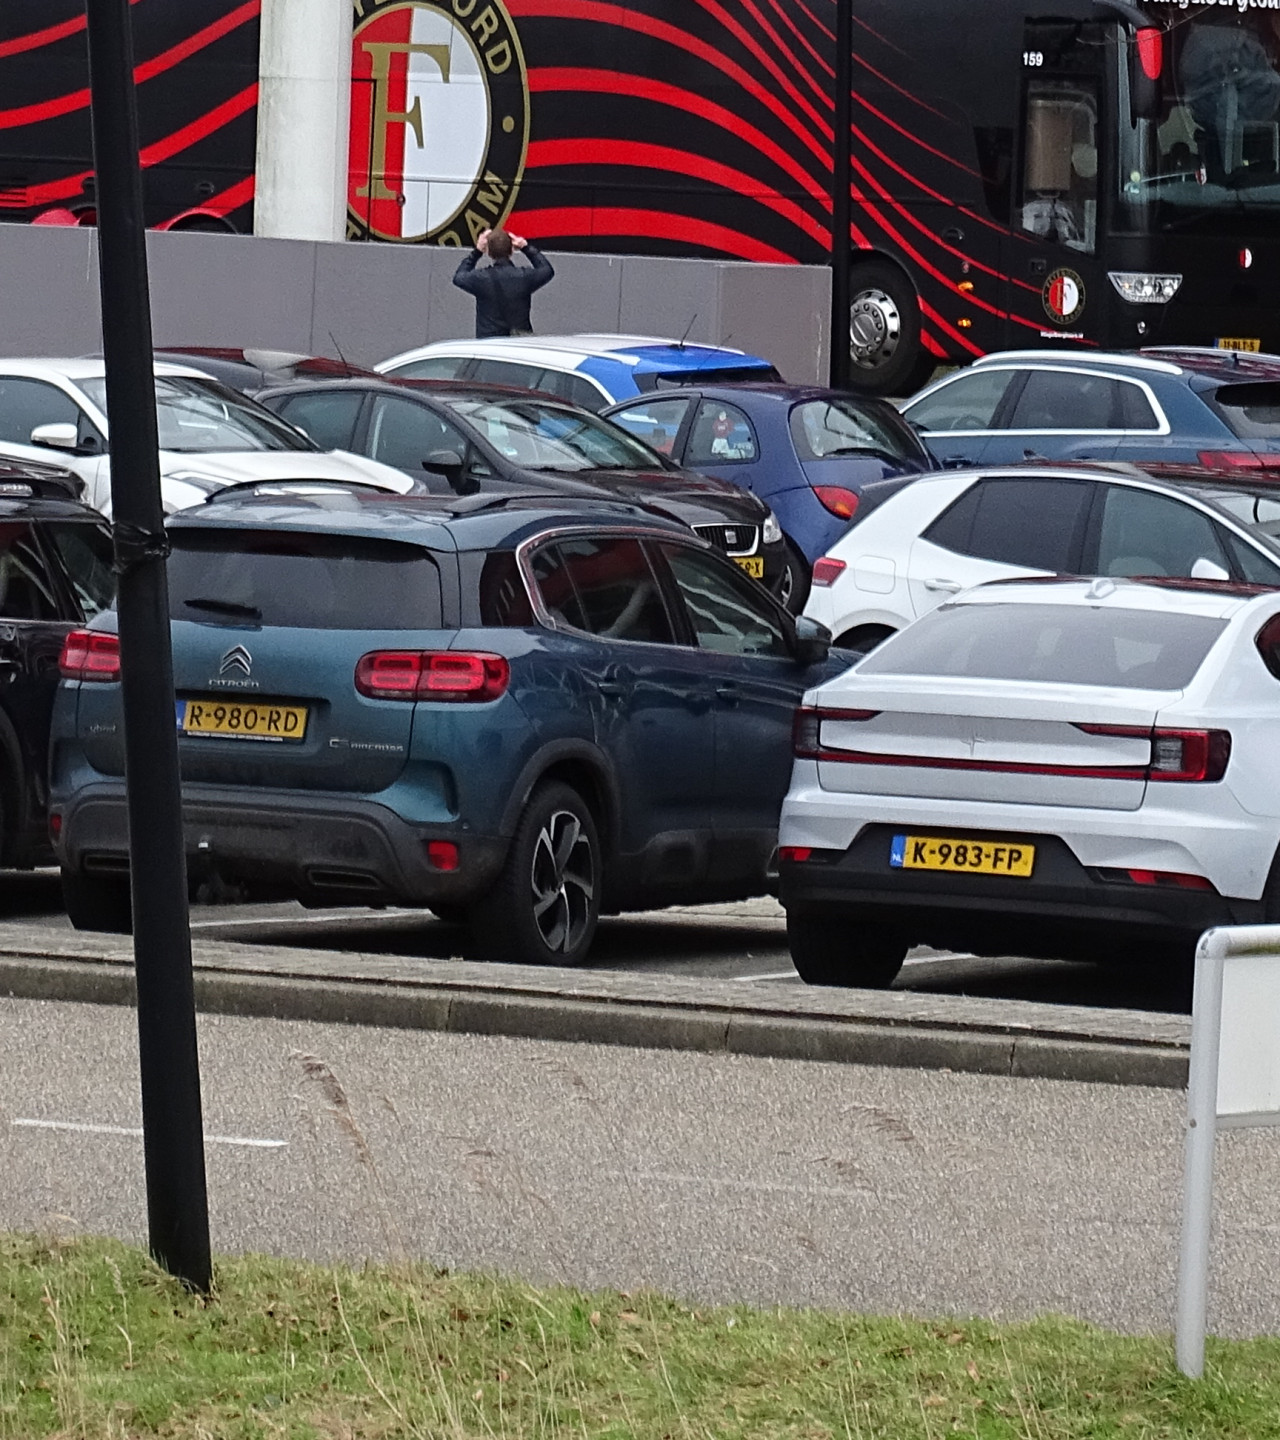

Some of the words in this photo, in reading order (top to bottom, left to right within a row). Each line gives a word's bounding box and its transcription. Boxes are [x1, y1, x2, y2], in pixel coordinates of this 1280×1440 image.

[1022, 51, 1044, 67] 159
[355, 42, 451, 201] F
[189, 704, 299, 733] R-980-RD
[912, 840, 1023, 871] K-983-FP
